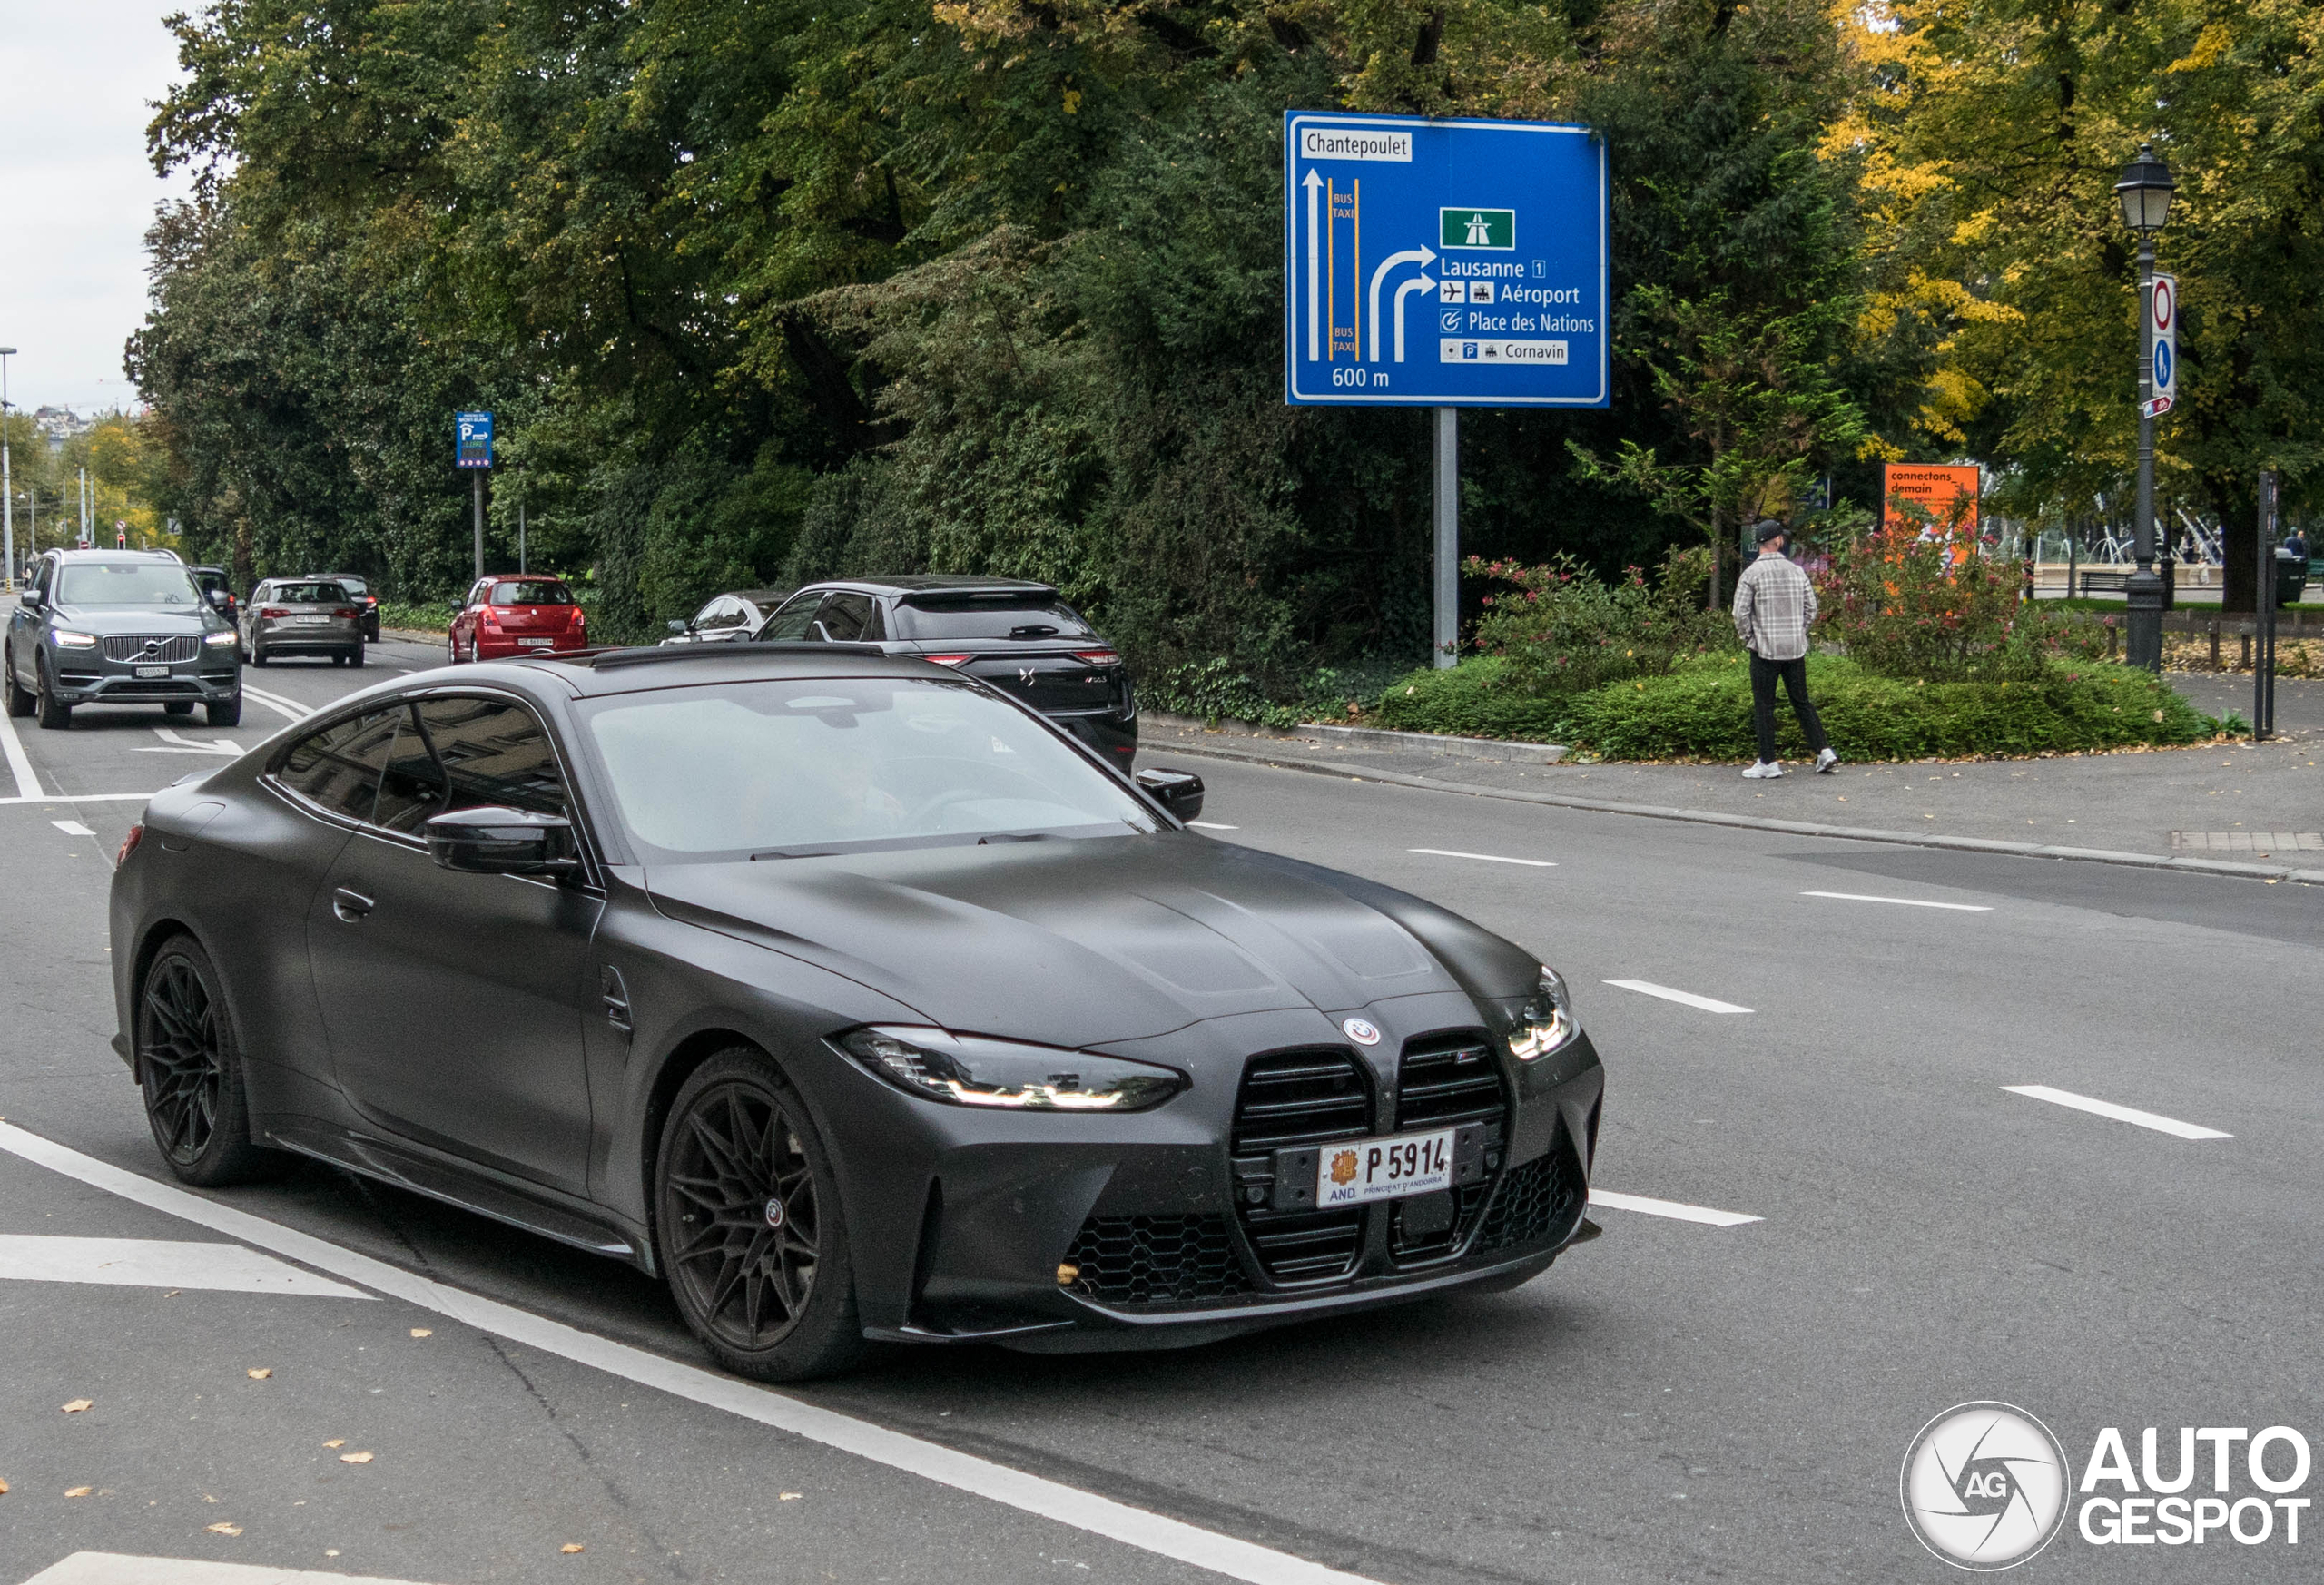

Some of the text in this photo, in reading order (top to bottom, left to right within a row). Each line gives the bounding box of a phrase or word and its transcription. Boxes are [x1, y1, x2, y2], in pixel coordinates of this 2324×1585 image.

[1307, 133, 1407, 158] Chantepoulet
[1334, 194, 1353, 204] BUS
[1332, 208, 1354, 219] TAXI
[1441, 257, 1524, 278] Lausanne
[1501, 284, 1580, 307] Aéroport
[1334, 327, 1353, 338] BUS
[1469, 313, 1595, 333] Place des Nations
[1333, 341, 1354, 352] TAXI
[1505, 344, 1564, 359] Cornavin
[1332, 368, 1389, 387] 600 m
[1891, 482, 1932, 493] demain
[1366, 1138, 1445, 1183] P 5914
[1364, 1176, 1442, 1195] PRINCIPAT D'ANDORRA
